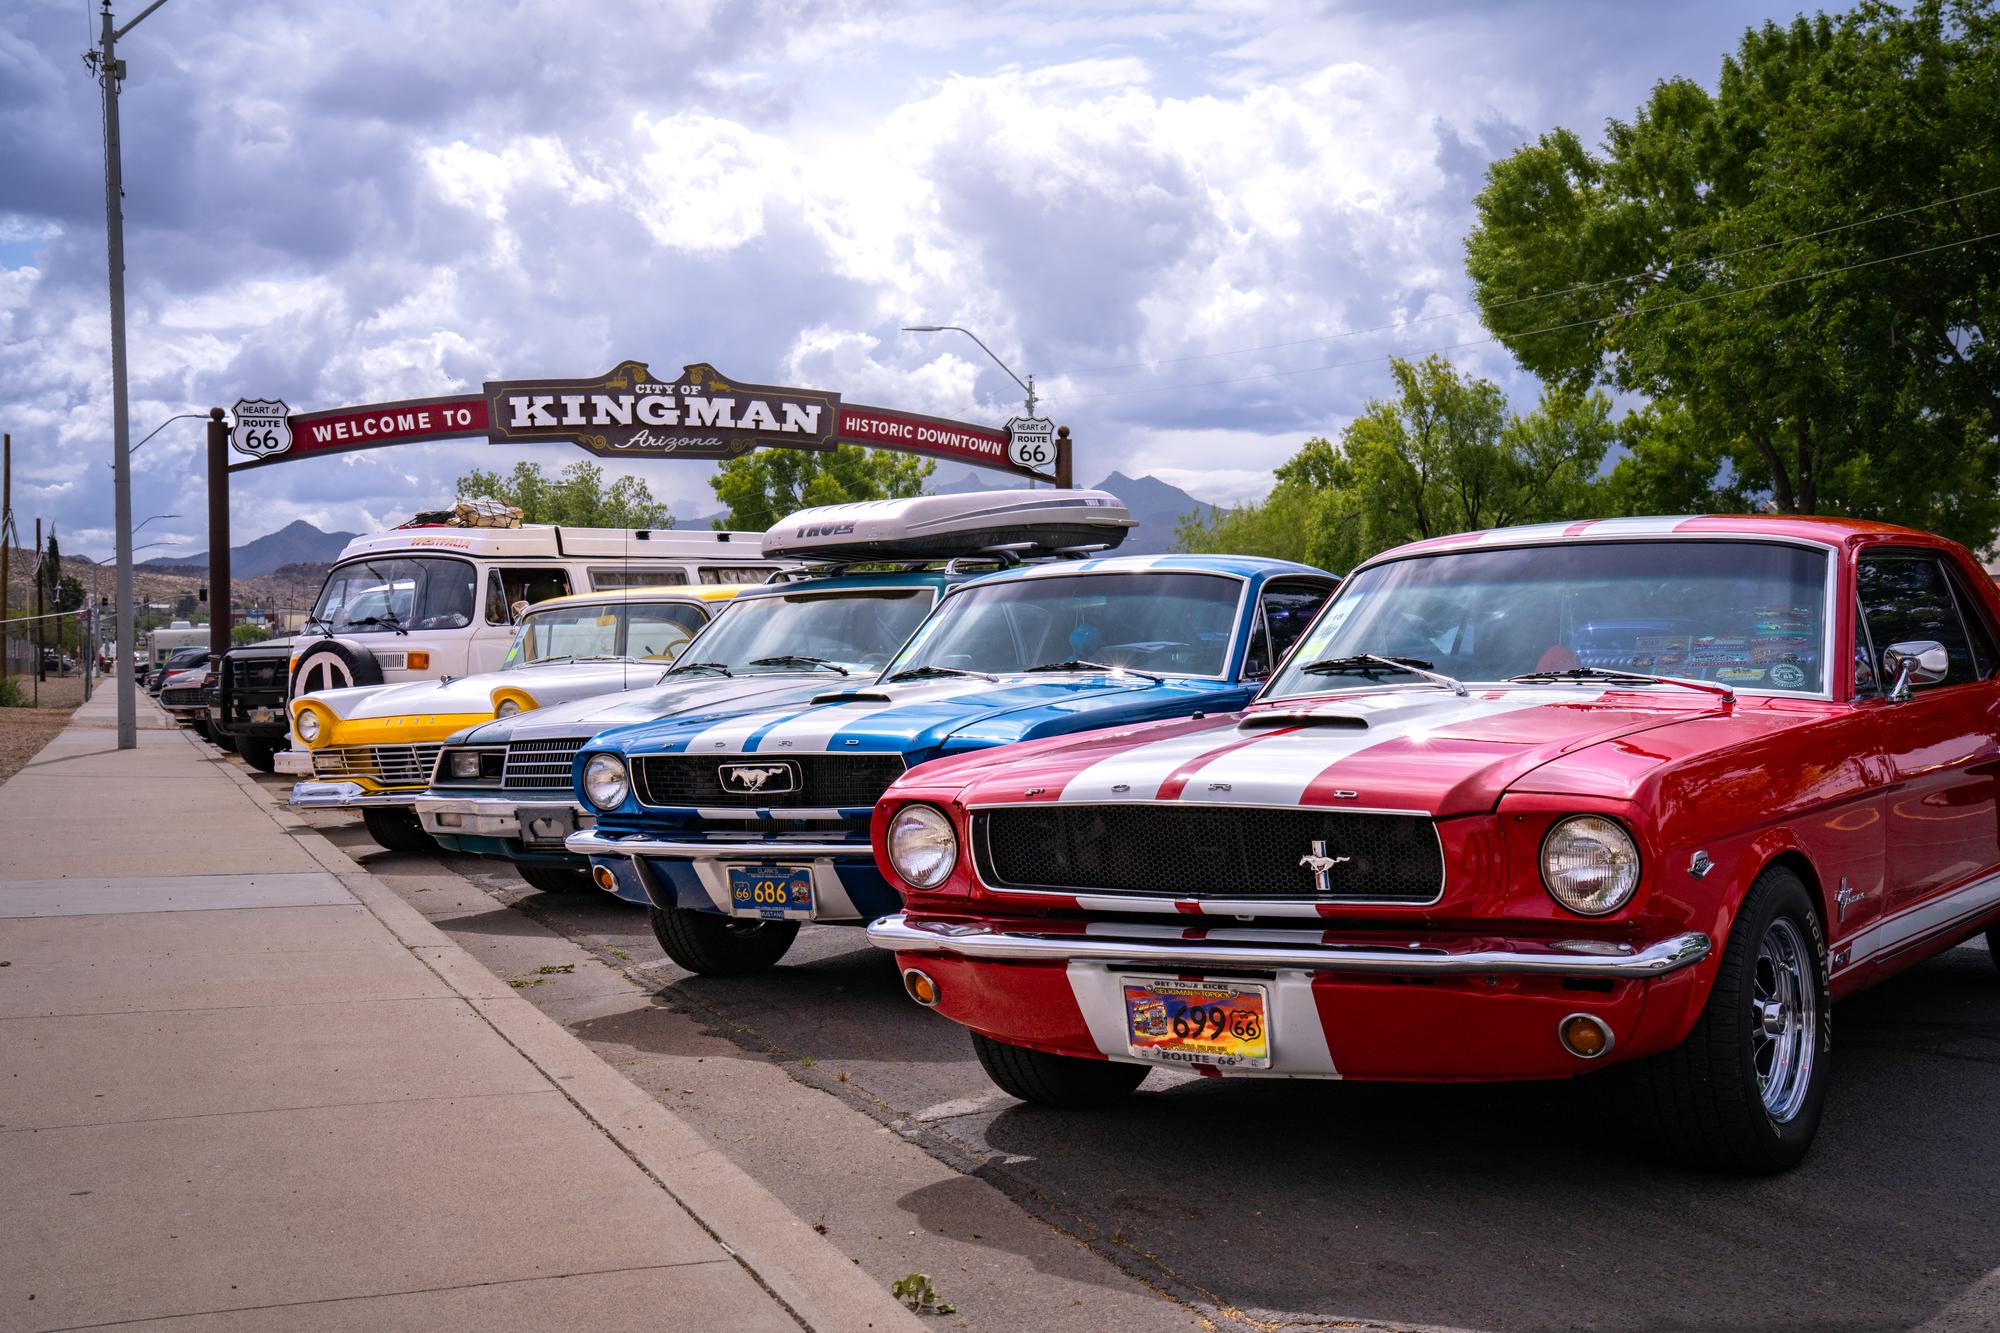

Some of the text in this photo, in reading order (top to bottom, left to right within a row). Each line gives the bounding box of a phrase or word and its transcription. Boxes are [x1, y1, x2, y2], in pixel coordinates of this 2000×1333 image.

[635, 384, 701, 395] CITY OF
[243, 406, 280, 415] HEART of
[509, 395, 822, 434] KINGMAN
[243, 419, 281, 428] ROUTE
[312, 408, 472, 442] WELCOME TO
[1017, 423, 1047, 431] HEART of
[245, 429, 279, 449] 66
[615, 430, 722, 452] Arizona
[846, 417, 1002, 456] HISTORIC DOWNTOWN
[1017, 435, 1048, 443] ROUTE
[1019, 444, 1046, 462] 66
[736, 887, 749, 899] 66
[754, 880, 787, 904] 686
[1202, 983, 1229, 991] KICKS
[1173, 1005, 1227, 1040] 699
[1233, 1020, 1257, 1037] 66
[1162, 1051, 1236, 1066] ROUTE 66
